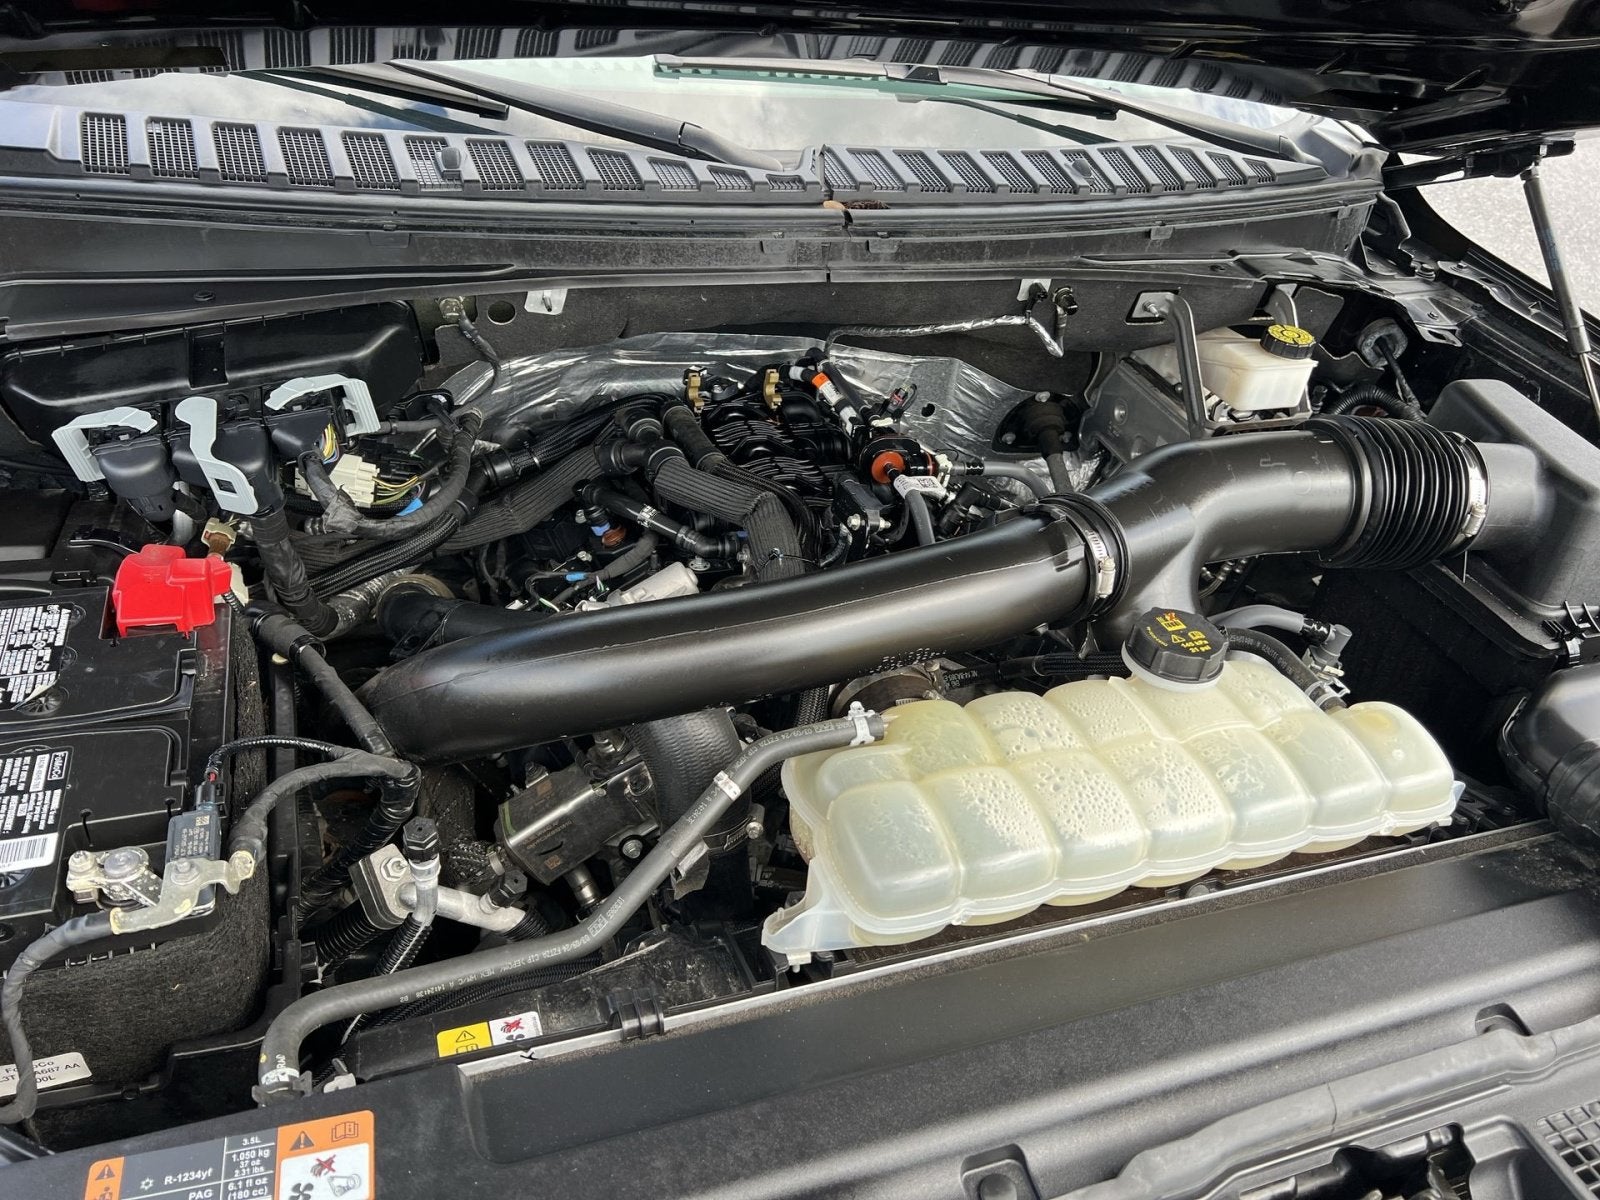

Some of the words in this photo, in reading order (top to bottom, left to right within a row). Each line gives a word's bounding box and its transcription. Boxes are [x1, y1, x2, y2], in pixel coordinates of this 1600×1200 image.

[52, 753, 65, 779] FoMoCo
[65, 1062, 81, 1070] AA
[242, 1136, 262, 1146] 3.5L
[232, 1150, 256, 1162] 1.050
[258, 1148, 270, 1158] kg
[239, 1160, 250, 1168] 37
[164, 1167, 213, 1186] R-1234yf
[234, 1167, 250, 1177] 2.31
[228, 1180, 243, 1191] 6.1
[246, 1178, 253, 1188] fl
[255, 1177, 268, 1186] oz
[188, 1188, 213, 1200] PAG
[252, 1185, 268, 1197] cc)
